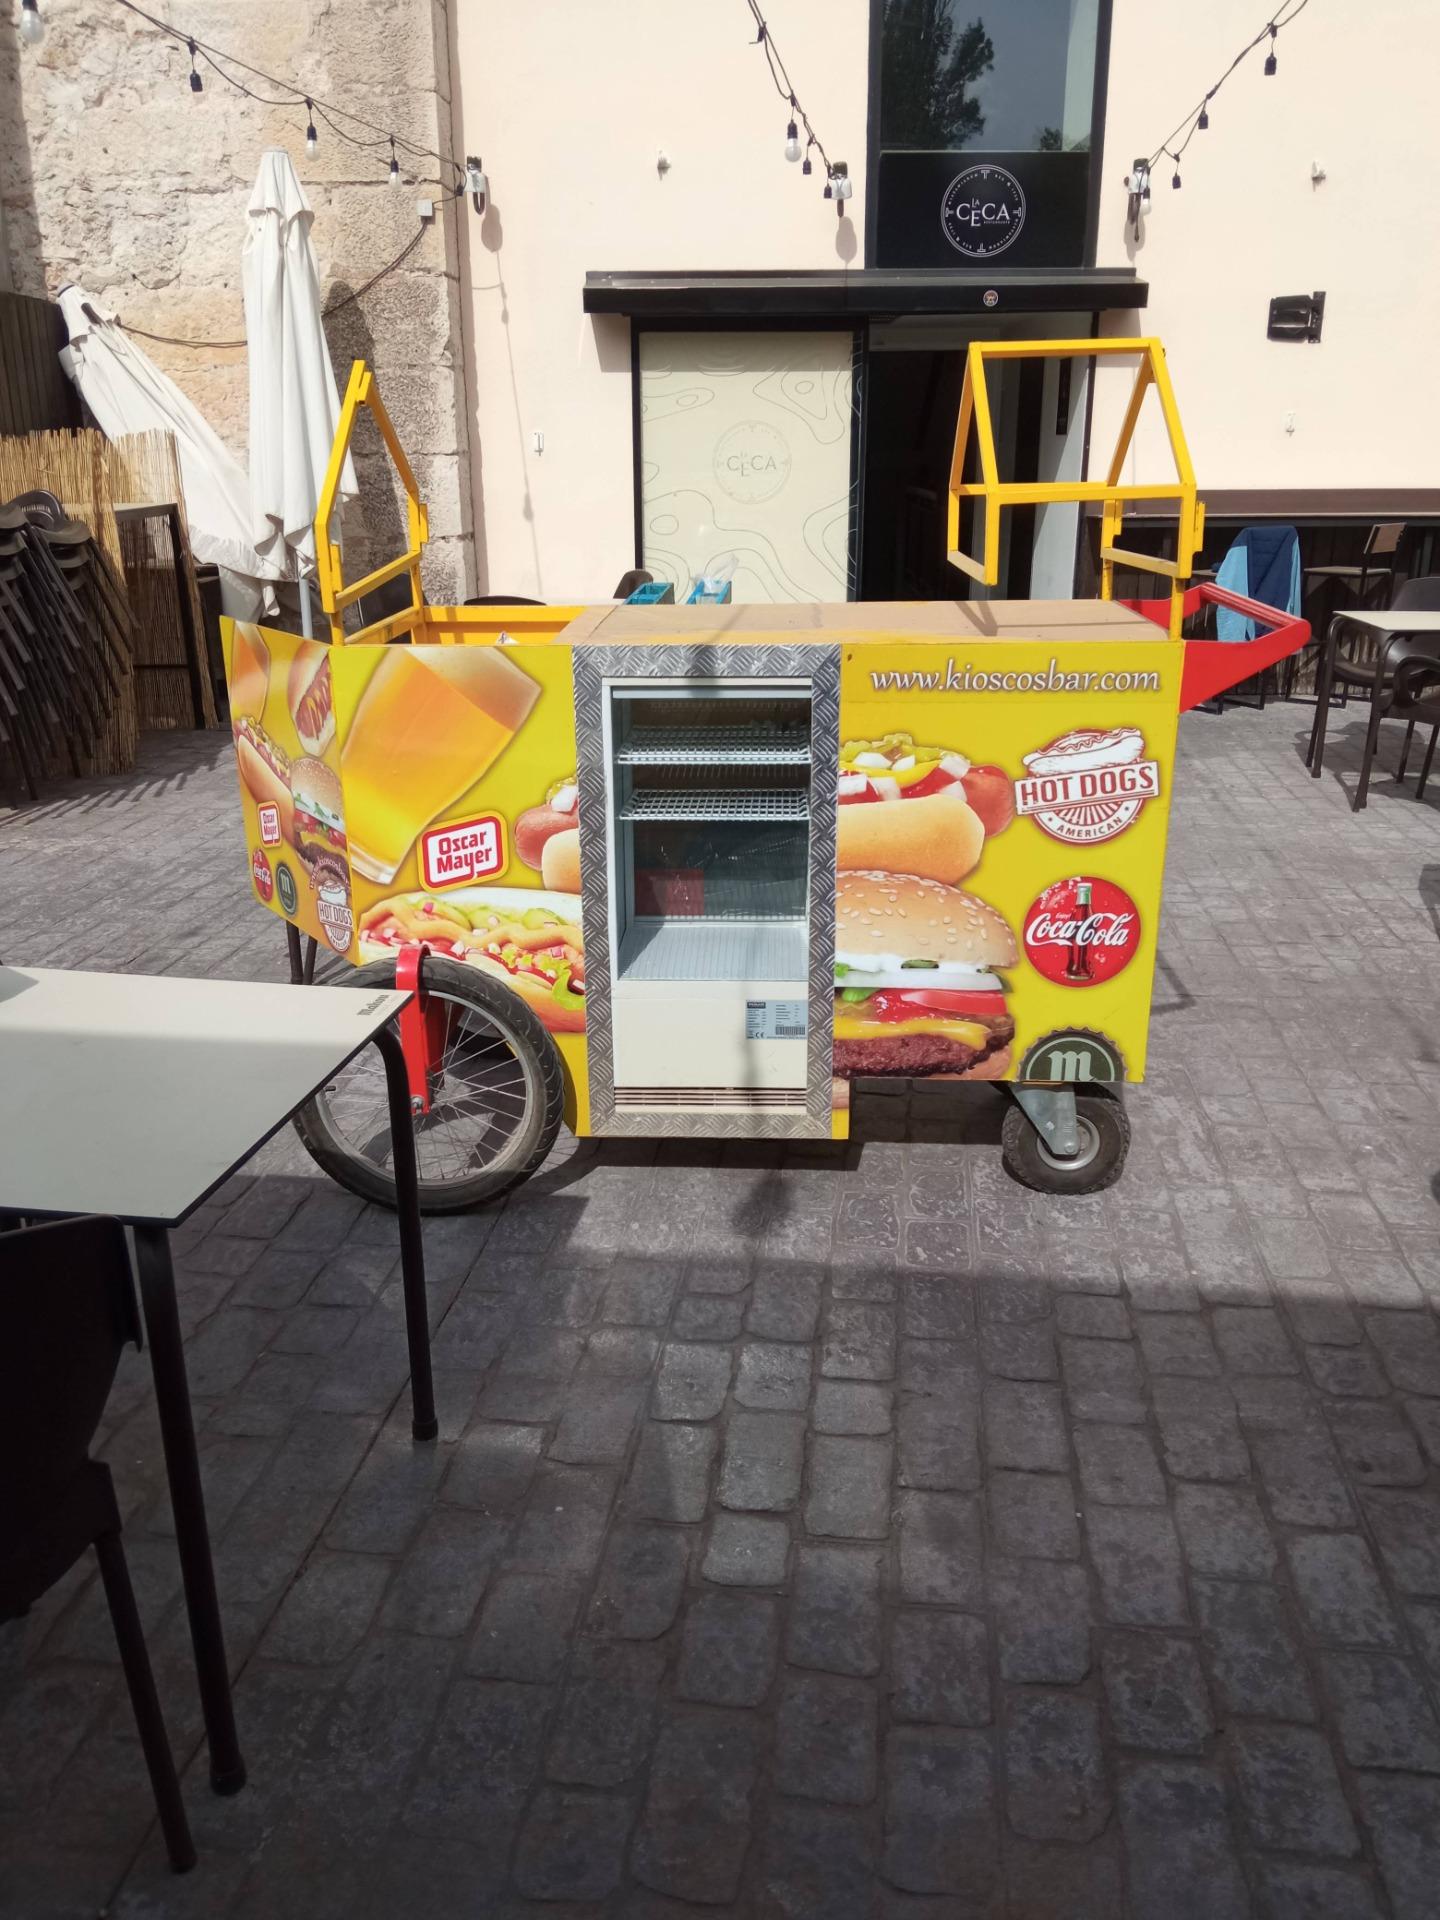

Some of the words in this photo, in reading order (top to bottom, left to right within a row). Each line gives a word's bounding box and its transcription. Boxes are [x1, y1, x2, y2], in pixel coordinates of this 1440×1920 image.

[956, 203, 1010, 227] CECA
[971, 197, 980, 208] LA
[869, 657, 1161, 692] www.kioscosbar.com
[1020, 776, 1073, 807] HOT
[1079, 765, 1155, 799] DOGS
[1056, 816, 1123, 838] AMERICAN
[438, 830, 487, 856] Oscar
[436, 847, 493, 877] Mayer
[1025, 912, 1136, 946] Coca-Cola
